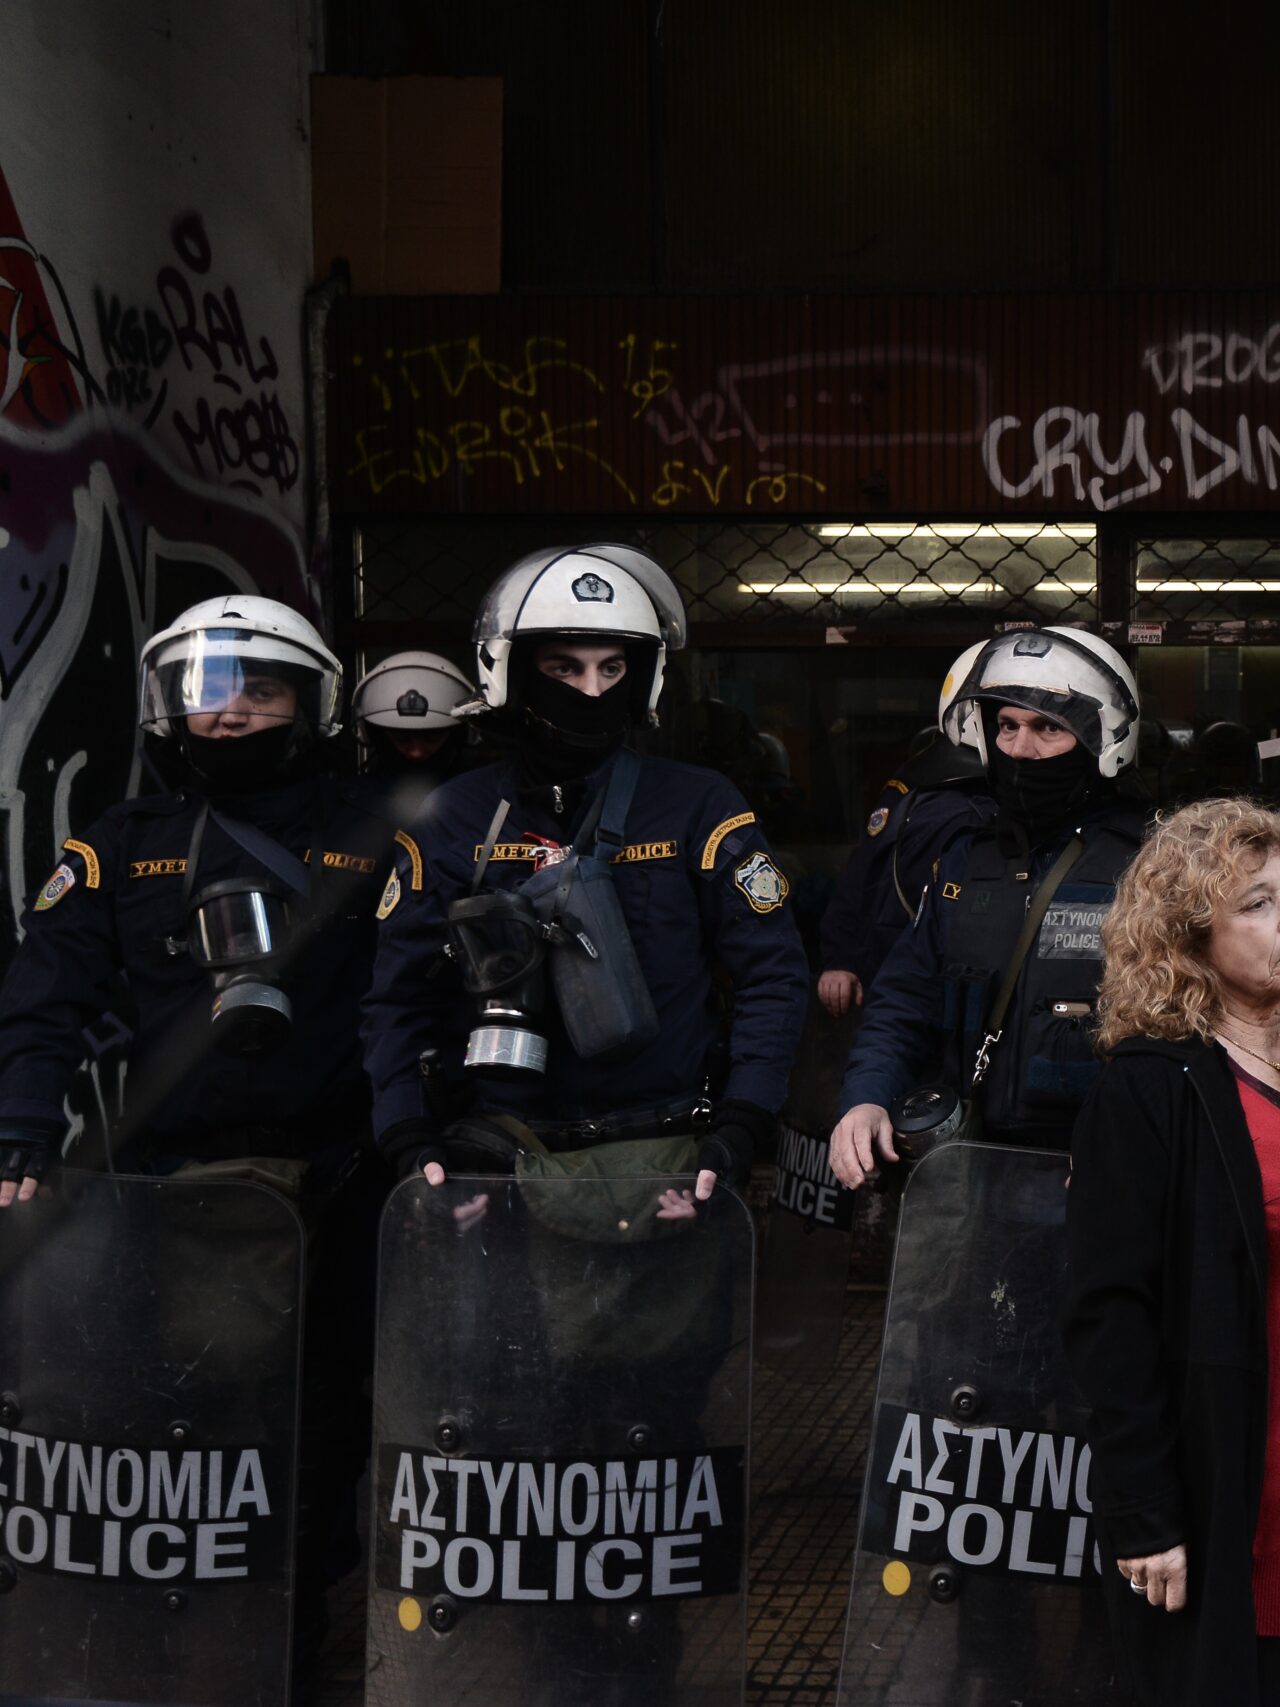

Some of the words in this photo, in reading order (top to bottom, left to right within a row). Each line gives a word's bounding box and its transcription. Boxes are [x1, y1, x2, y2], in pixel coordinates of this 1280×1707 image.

[1054, 933, 1100, 949] POLICE
[389, 1452, 724, 1536] ΑΣΤΥΝΟΜΙΑ
[0, 1505, 249, 1580] OLICE
[400, 1529, 703, 1600] POLICE
[893, 1491, 1102, 1577] POLI
